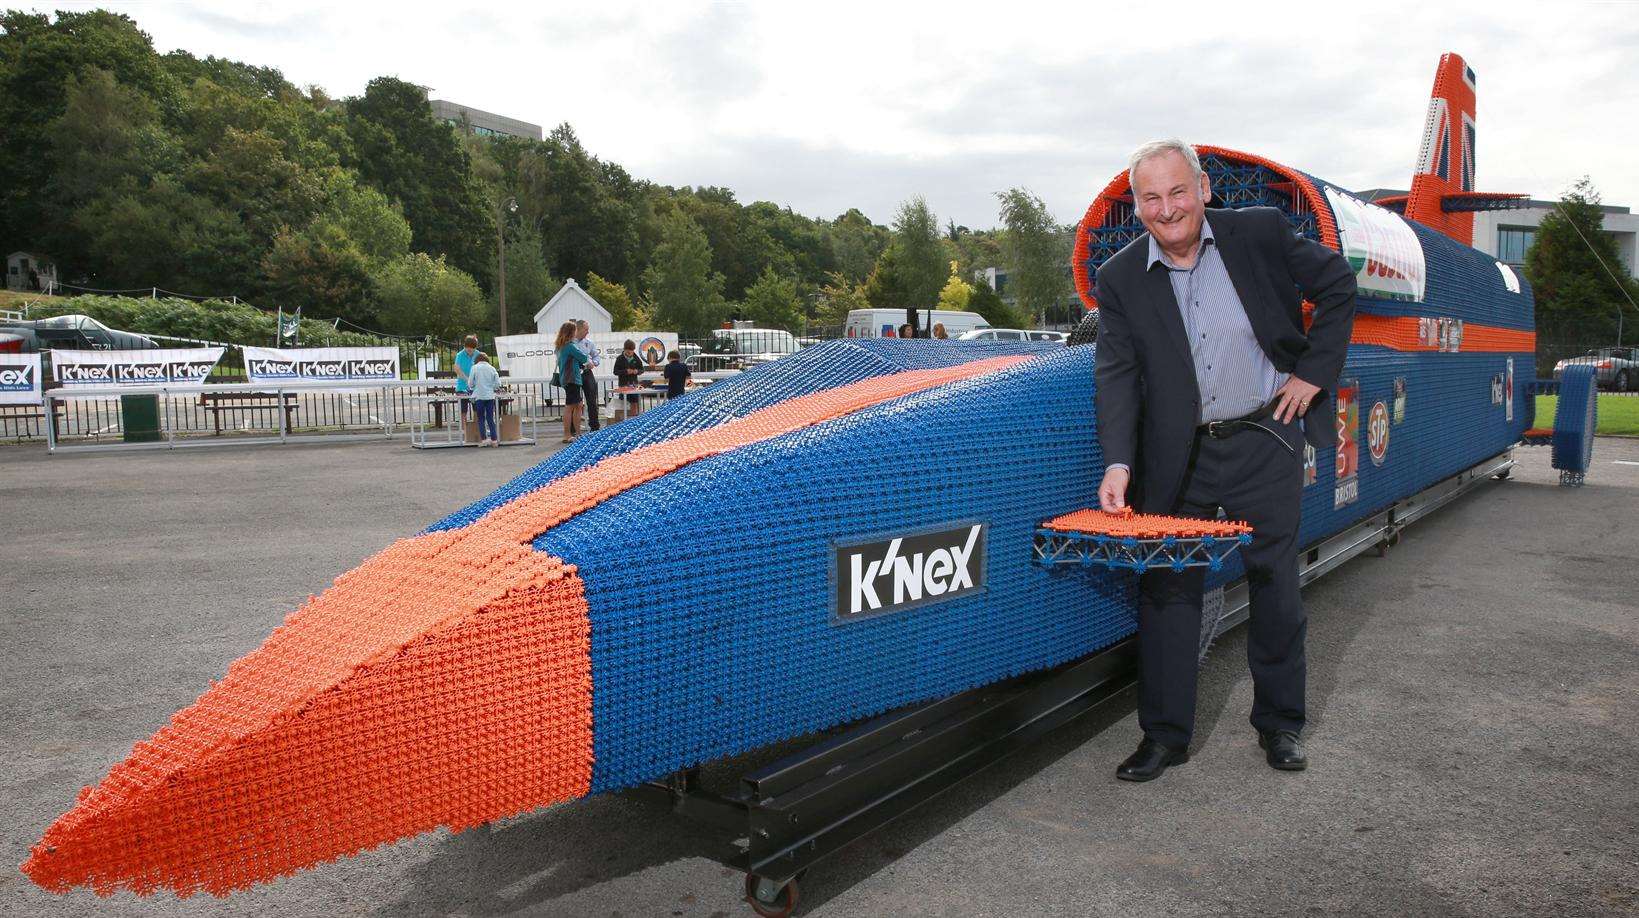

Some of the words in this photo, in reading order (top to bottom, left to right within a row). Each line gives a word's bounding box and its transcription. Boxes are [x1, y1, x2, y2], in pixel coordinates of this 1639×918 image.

[1338, 398, 1346, 474] UWE
[1371, 408, 1386, 450] STP
[1335, 481, 1358, 505] BRISTOL
